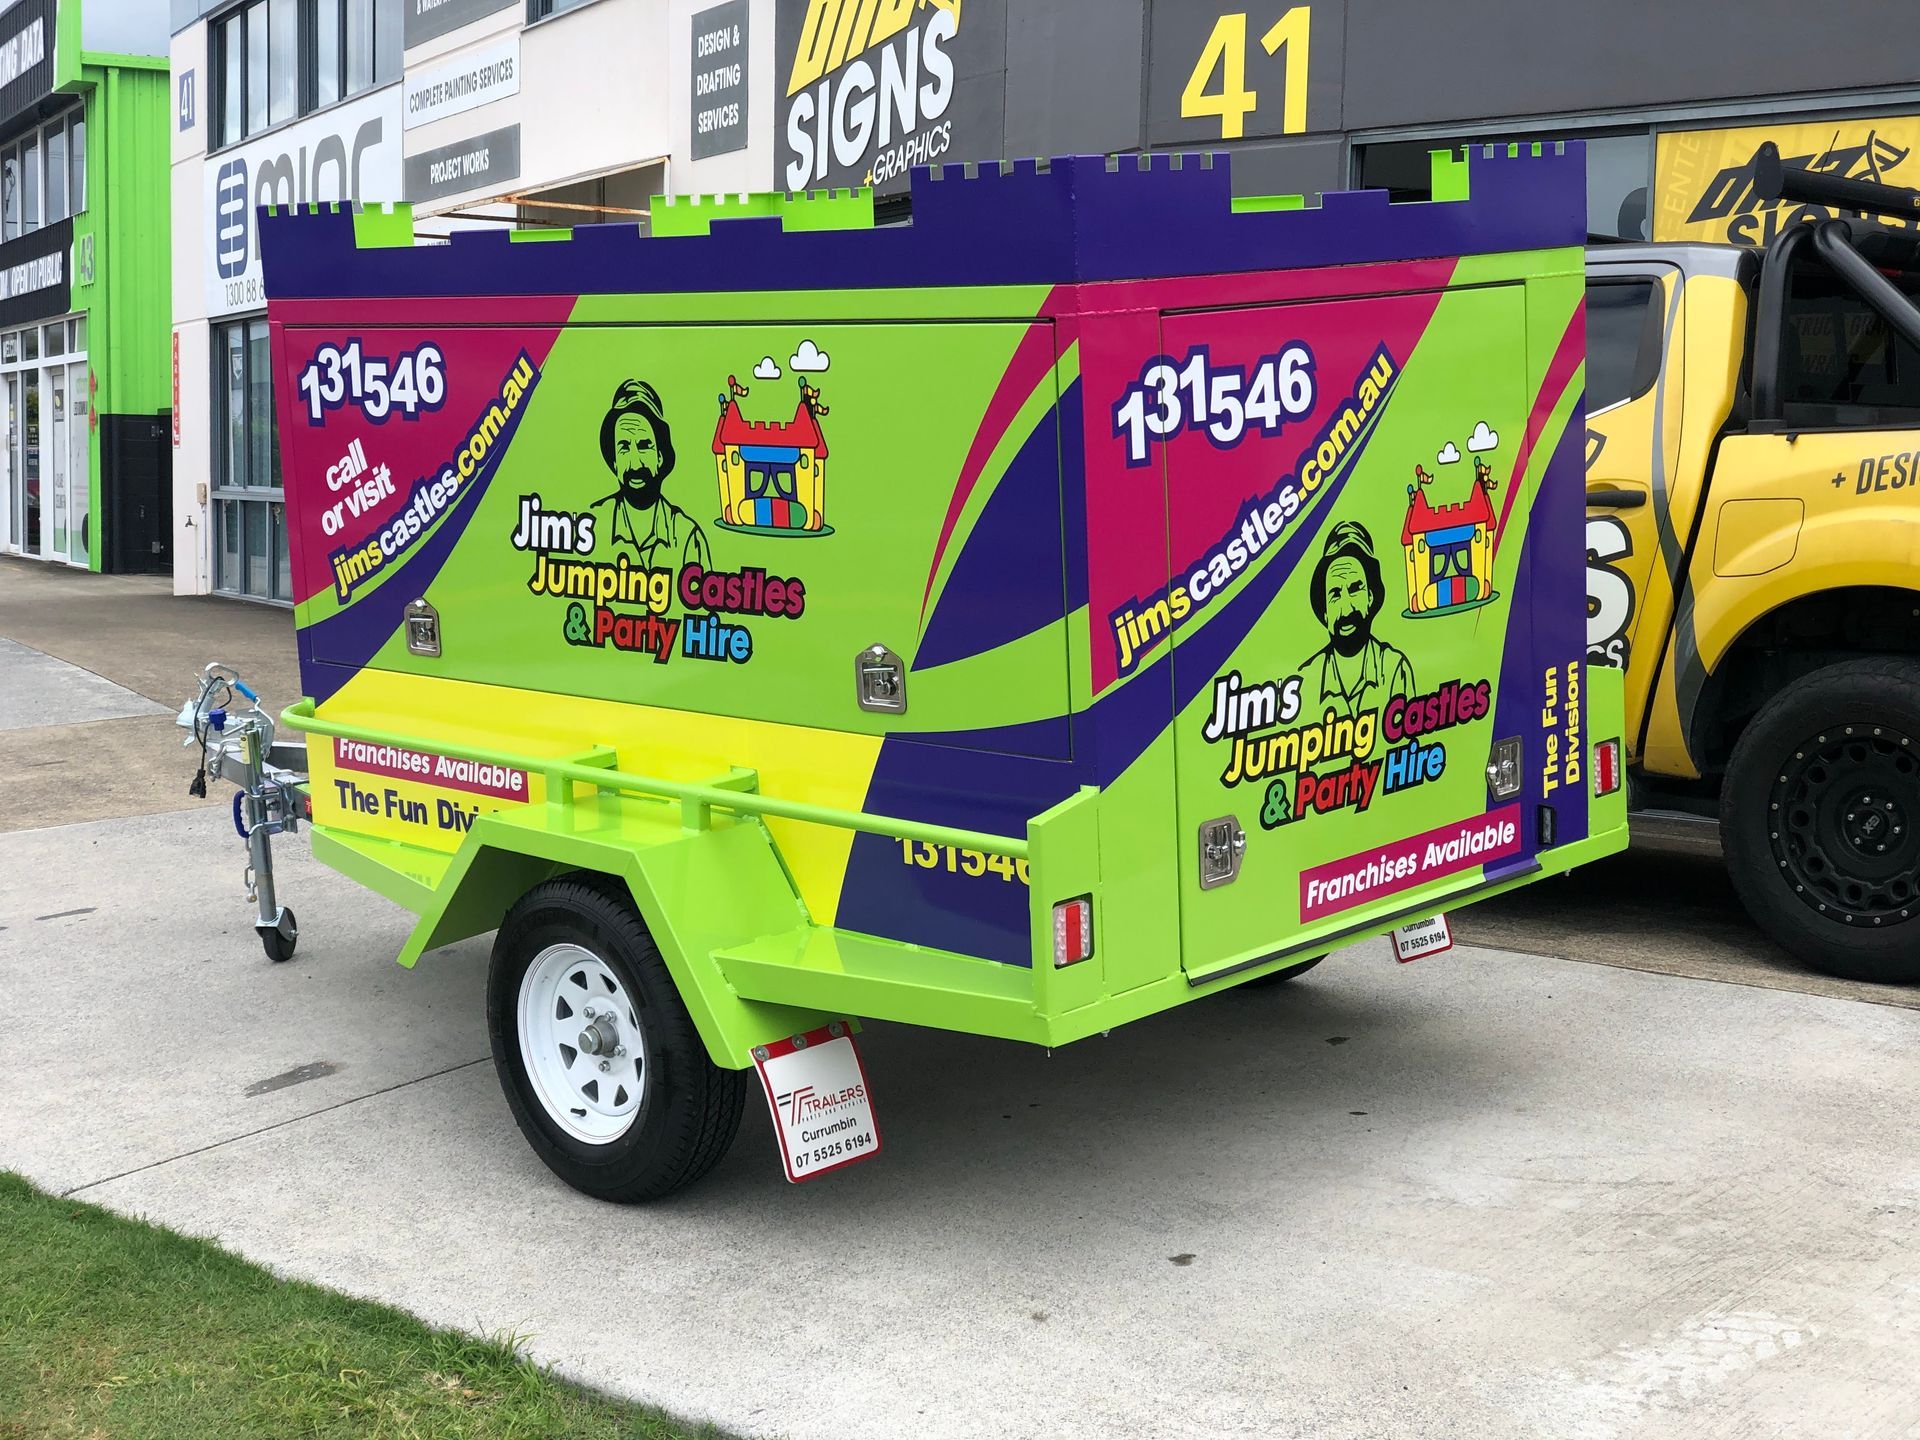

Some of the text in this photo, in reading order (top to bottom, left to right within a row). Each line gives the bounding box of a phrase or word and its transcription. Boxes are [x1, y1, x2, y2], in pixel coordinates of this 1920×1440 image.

[698, 24, 740, 58] DESIGN &
[181, 76, 192, 122] 41
[409, 57, 513, 113] COMPLETE PAINTING SERVICES
[697, 63, 741, 96] DRAFTING
[1180, 6, 1311, 138] 41
[698, 102, 739, 133] SERVICES
[786, 8, 958, 192] SIGNS
[430, 148, 489, 184] PROJECT WORKS
[38, 250, 62, 288] PUBLIC
[81, 235, 94, 281] 43
[225, 281, 244, 307] 1300
[246, 278, 257, 303] 88
[301, 343, 444, 419] 131546
[1117, 347, 1312, 460] 131546
[325, 438, 368, 492] call
[333, 356, 534, 597] jimscastles.com.au
[321, 462, 396, 536] or visit
[513, 497, 595, 552] Jim's
[1114, 353, 1394, 668] jimscastles.com.au
[530, 555, 805, 616] Jumping Castles
[565, 605, 750, 660] & Party Hire
[1205, 675, 1300, 739] Jim's
[1224, 683, 1489, 782] Jumping Castles
[1542, 666, 1559, 799] The Fun
[1564, 660, 1580, 785] Division
[339, 738, 523, 791] Franchises Available
[1263, 741, 1444, 829] & Party Hire
[334, 778, 379, 815] The
[384, 788, 429, 825] Fun
[1306, 820, 1516, 909] Franchises Available
[1400, 930, 1446, 952] 07 5525 6194
[804, 1084, 864, 1114] TRAILERS
[795, 1131, 872, 1168] 07 5525 6194
[801, 1117, 857, 1143] Currumbin
